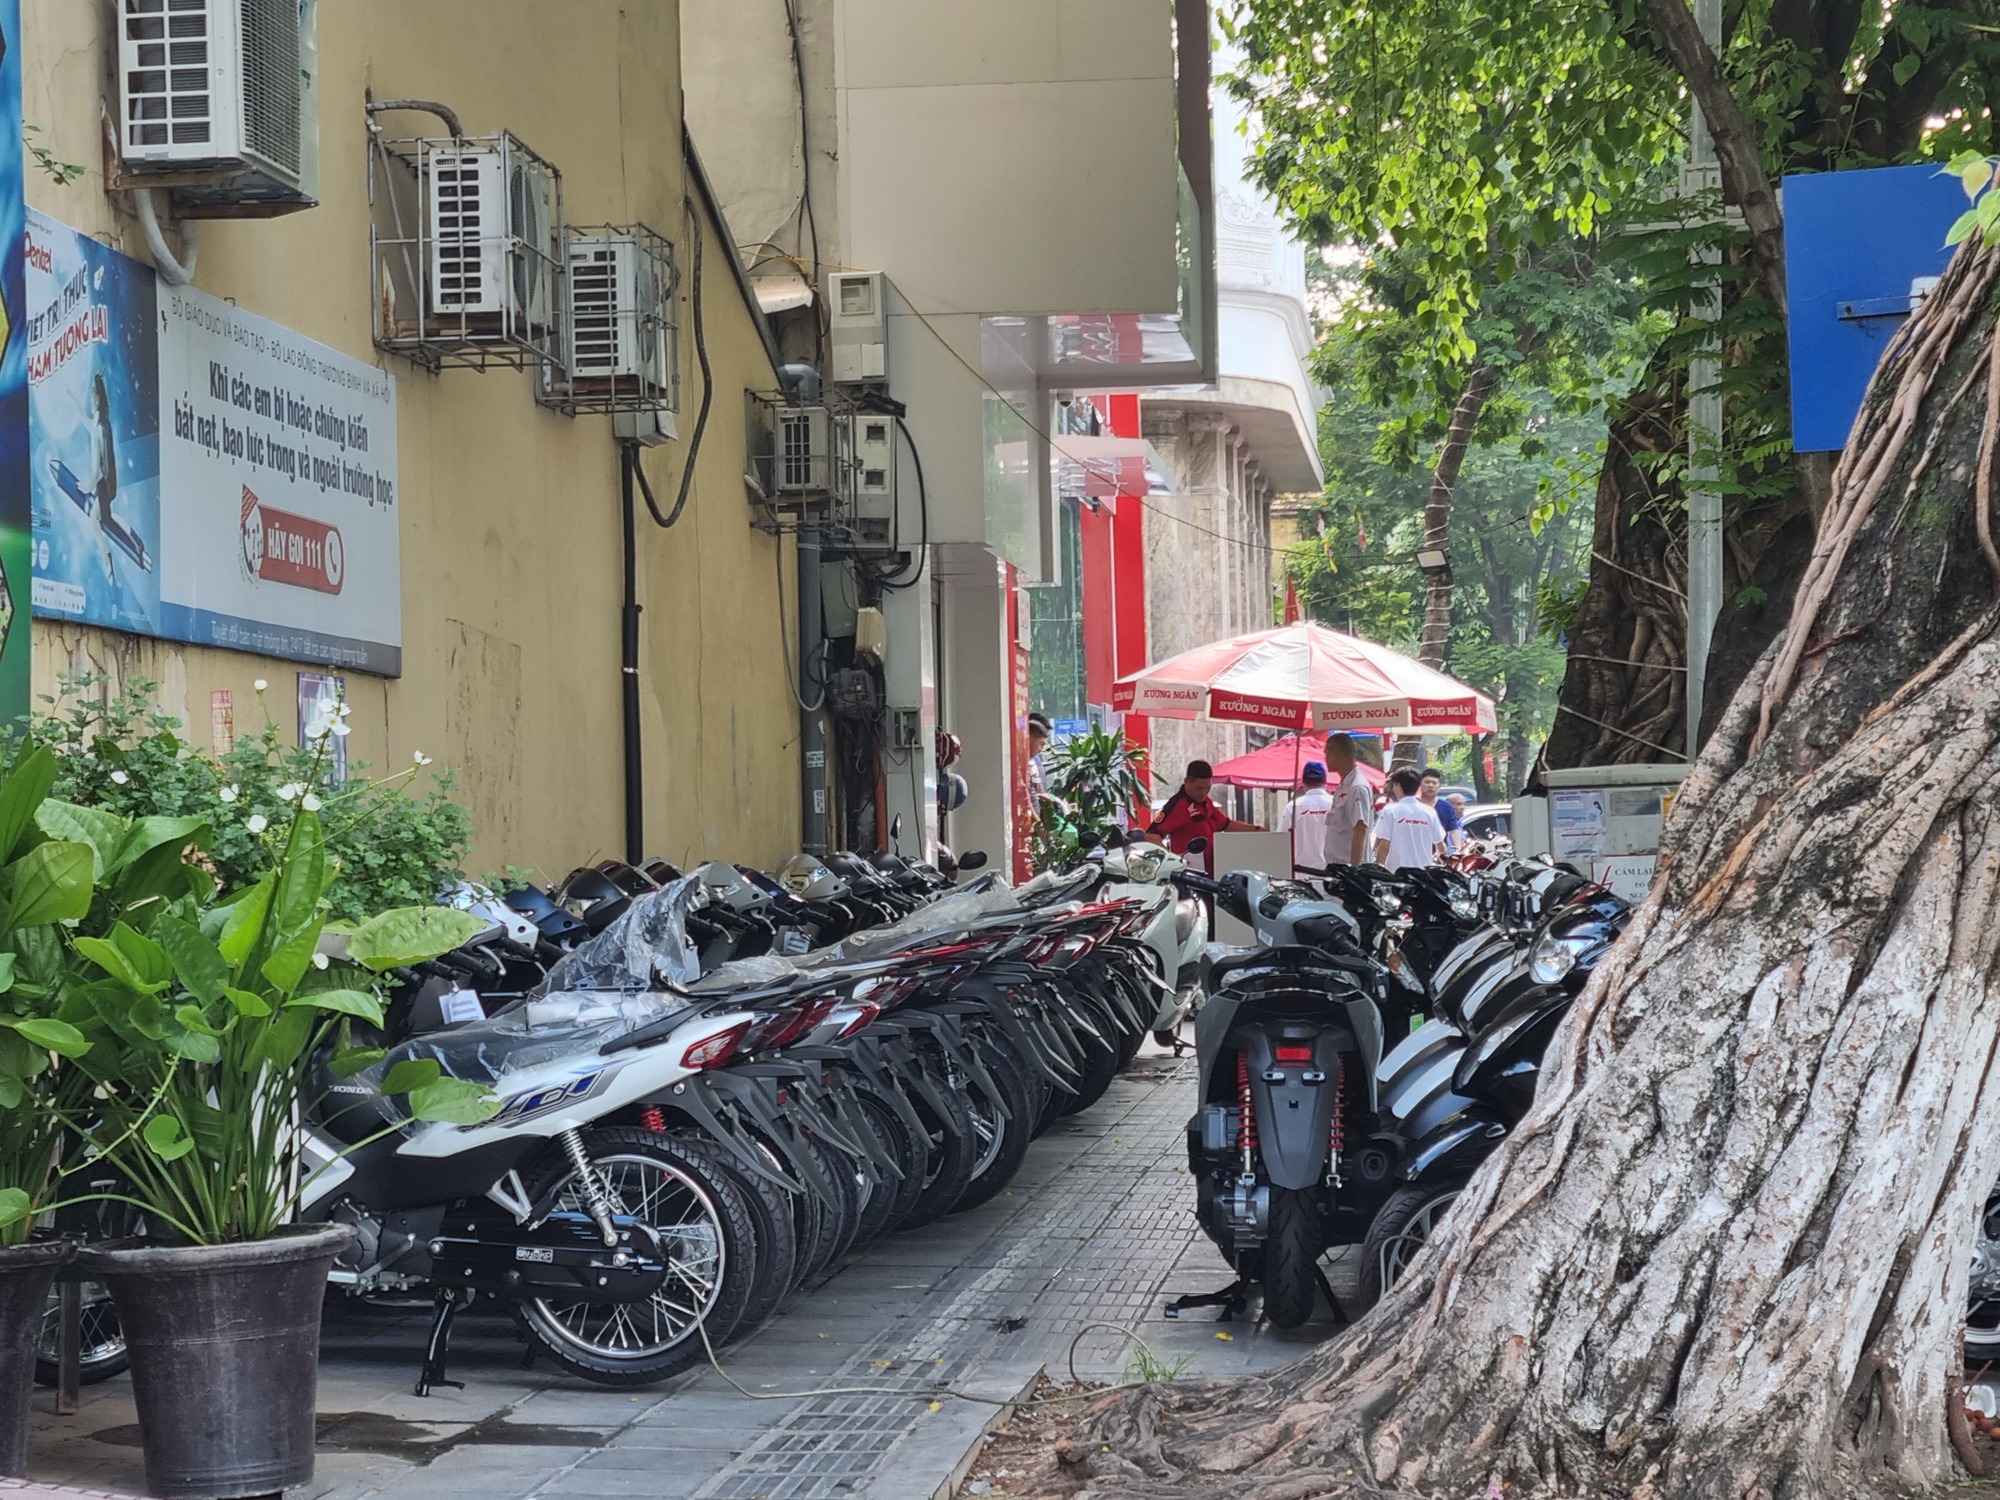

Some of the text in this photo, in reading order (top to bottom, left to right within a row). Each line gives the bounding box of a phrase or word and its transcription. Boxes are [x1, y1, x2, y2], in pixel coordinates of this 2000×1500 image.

[24, 231, 52, 274] Pentel
[28, 348, 51, 381] HẠM
[91, 306, 108, 340] LAI
[172, 295, 183, 320] BỘ
[185, 302, 203, 327] GIÁO
[271, 340, 281, 361] BỘ
[283, 347, 296, 366] LAO
[209, 360, 368, 453] Khi các em bị hoặc chứng kiến
[174, 390, 393, 512] bắt nạt, bạo lực trong và ngoài trường học
[268, 522, 287, 561] HÃY
[289, 533, 304, 572] GỌI
[305, 538, 321, 570] 111
